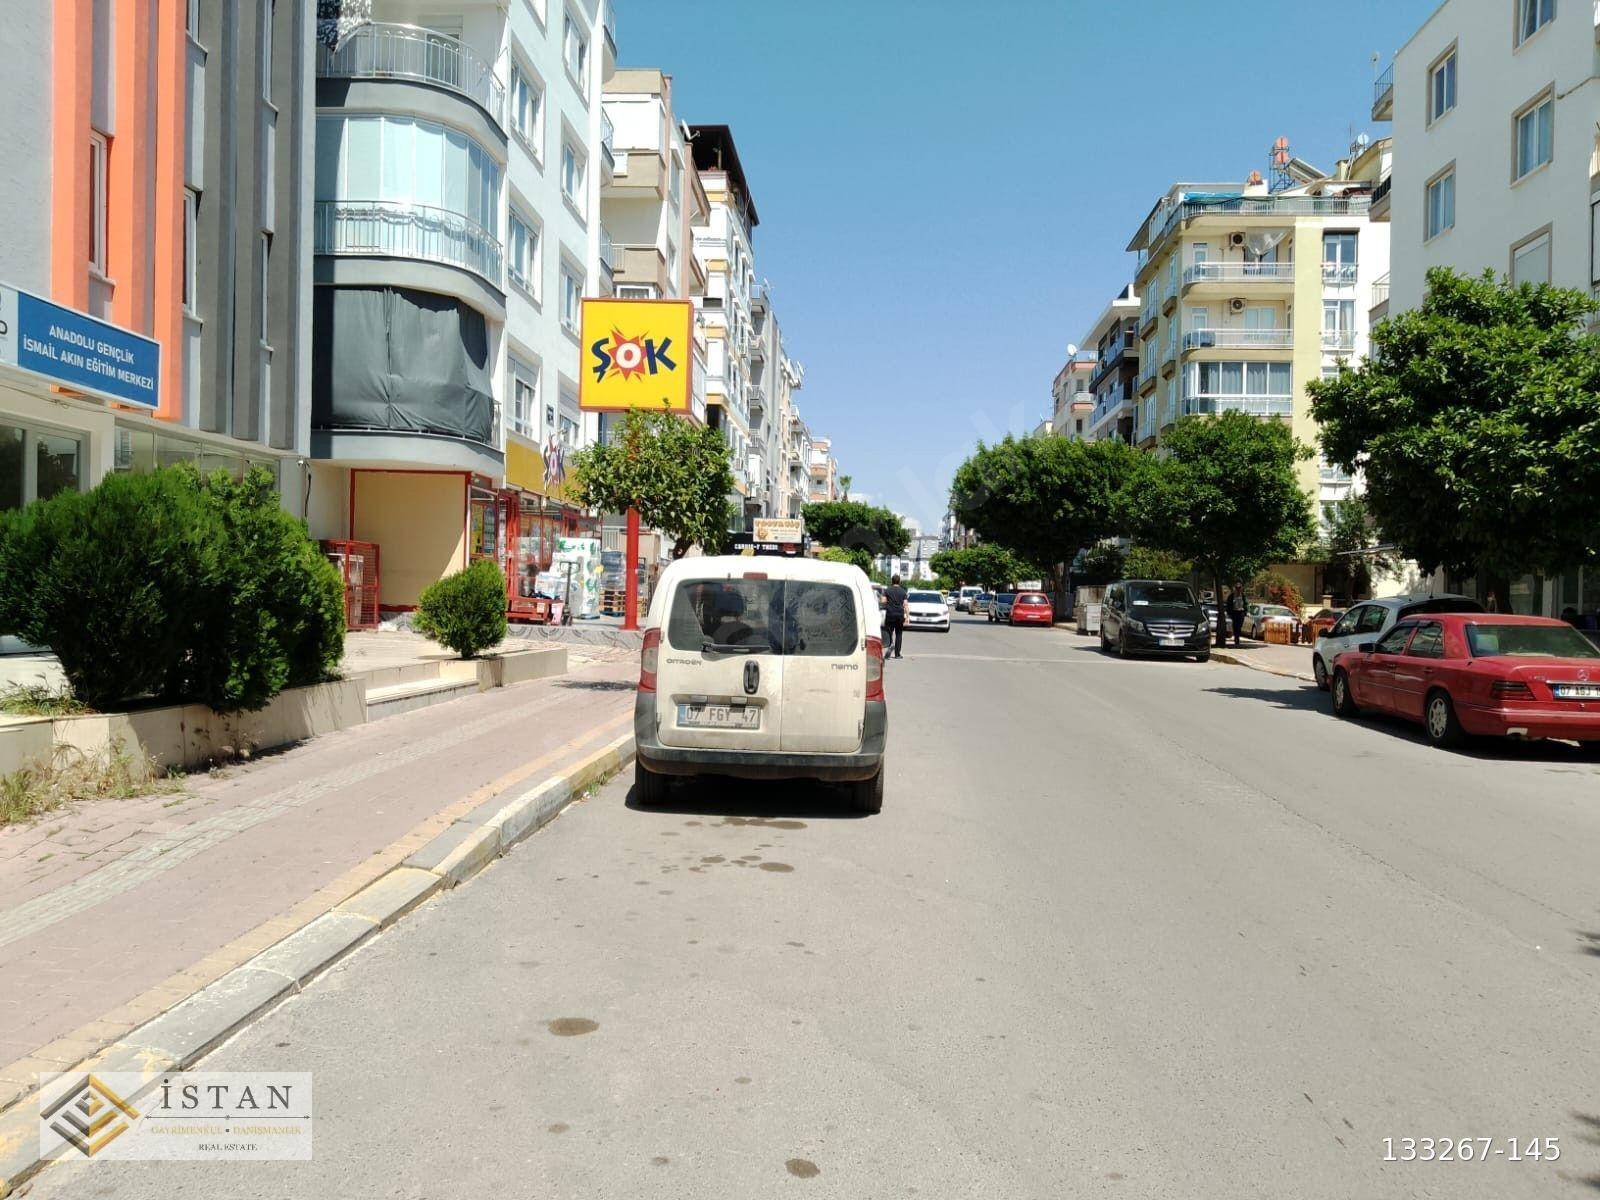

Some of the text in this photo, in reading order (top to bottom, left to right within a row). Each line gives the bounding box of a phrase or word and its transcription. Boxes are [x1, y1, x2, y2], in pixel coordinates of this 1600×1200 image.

[23, 334, 154, 391] İSMAİL AKIN EĞİTİM MERKEZİ
[49, 325, 135, 365] ANADOLU GENÇLİK
[591, 337, 677, 383] ŞOK
